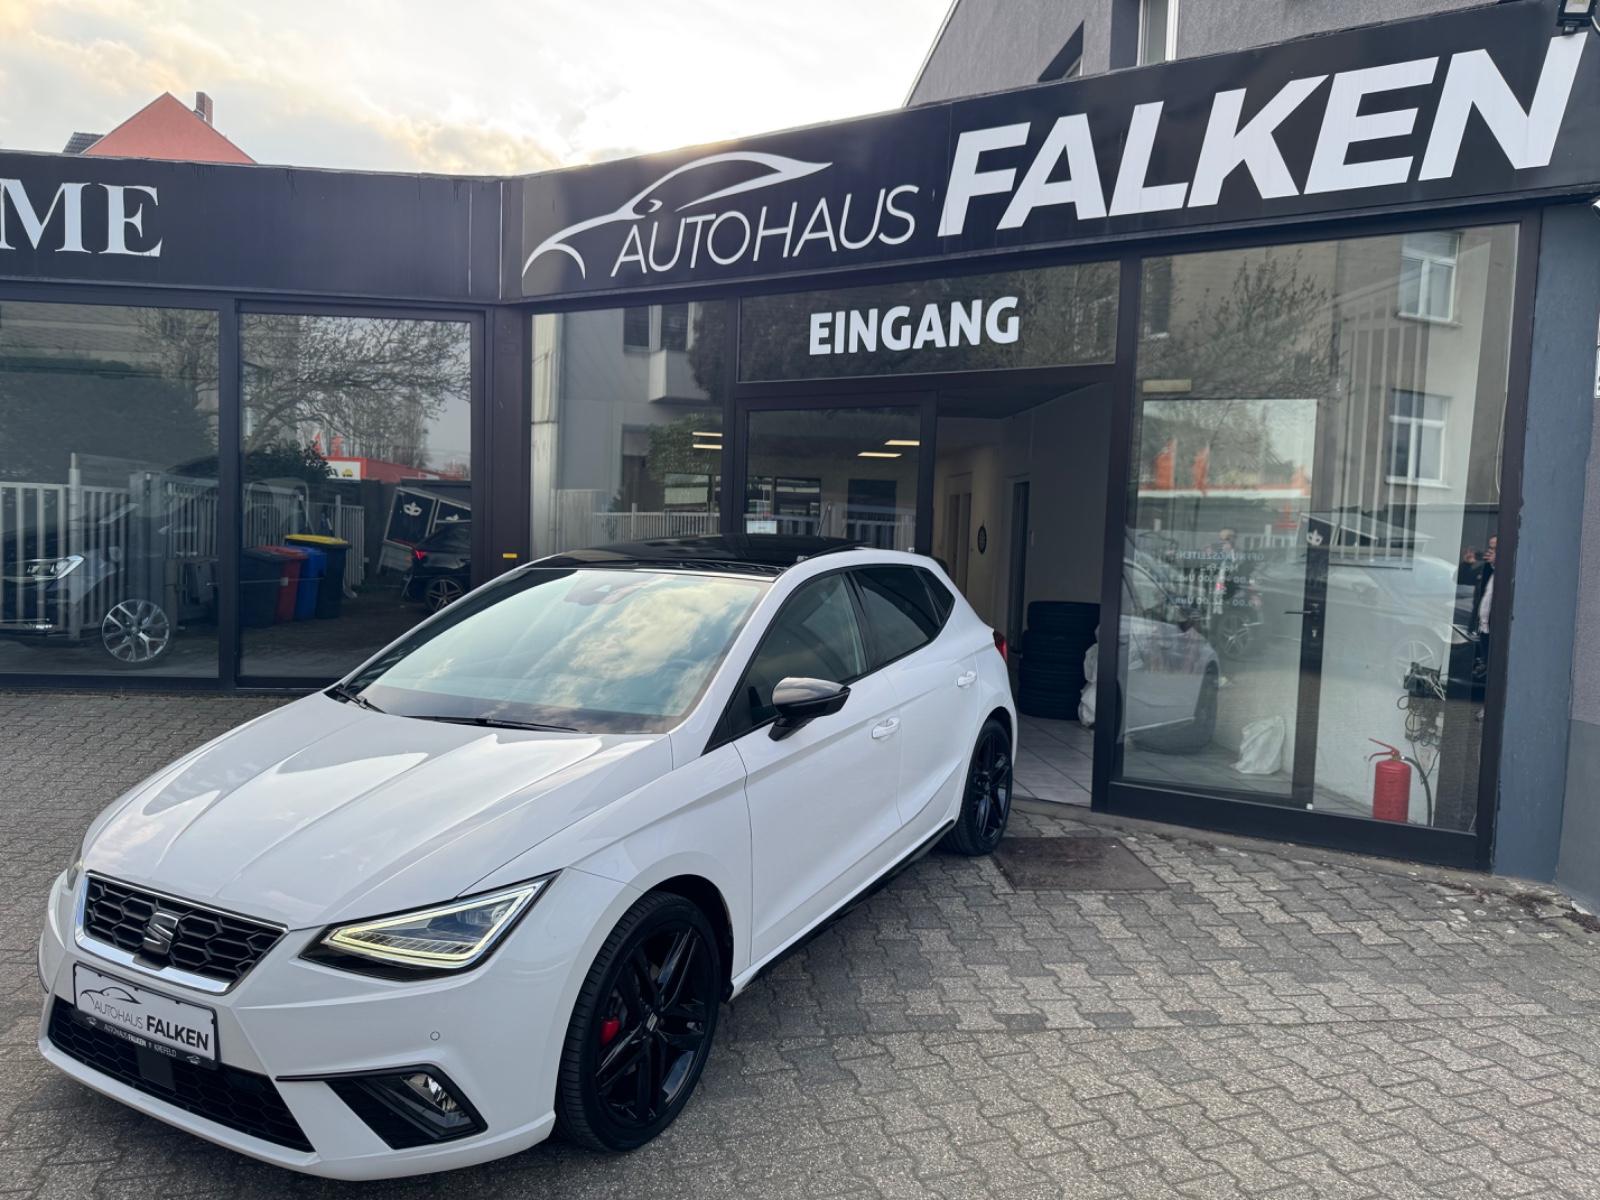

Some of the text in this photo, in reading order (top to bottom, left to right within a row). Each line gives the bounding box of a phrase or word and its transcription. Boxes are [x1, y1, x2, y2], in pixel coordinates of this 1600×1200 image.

[610, 33, 1587, 278] AUTOHAUS FALKEN
[0, 178, 163, 257] ME
[809, 297, 1019, 356] EINGANG
[94, 1001, 209, 1051] AUTOHAUS FALKEN
